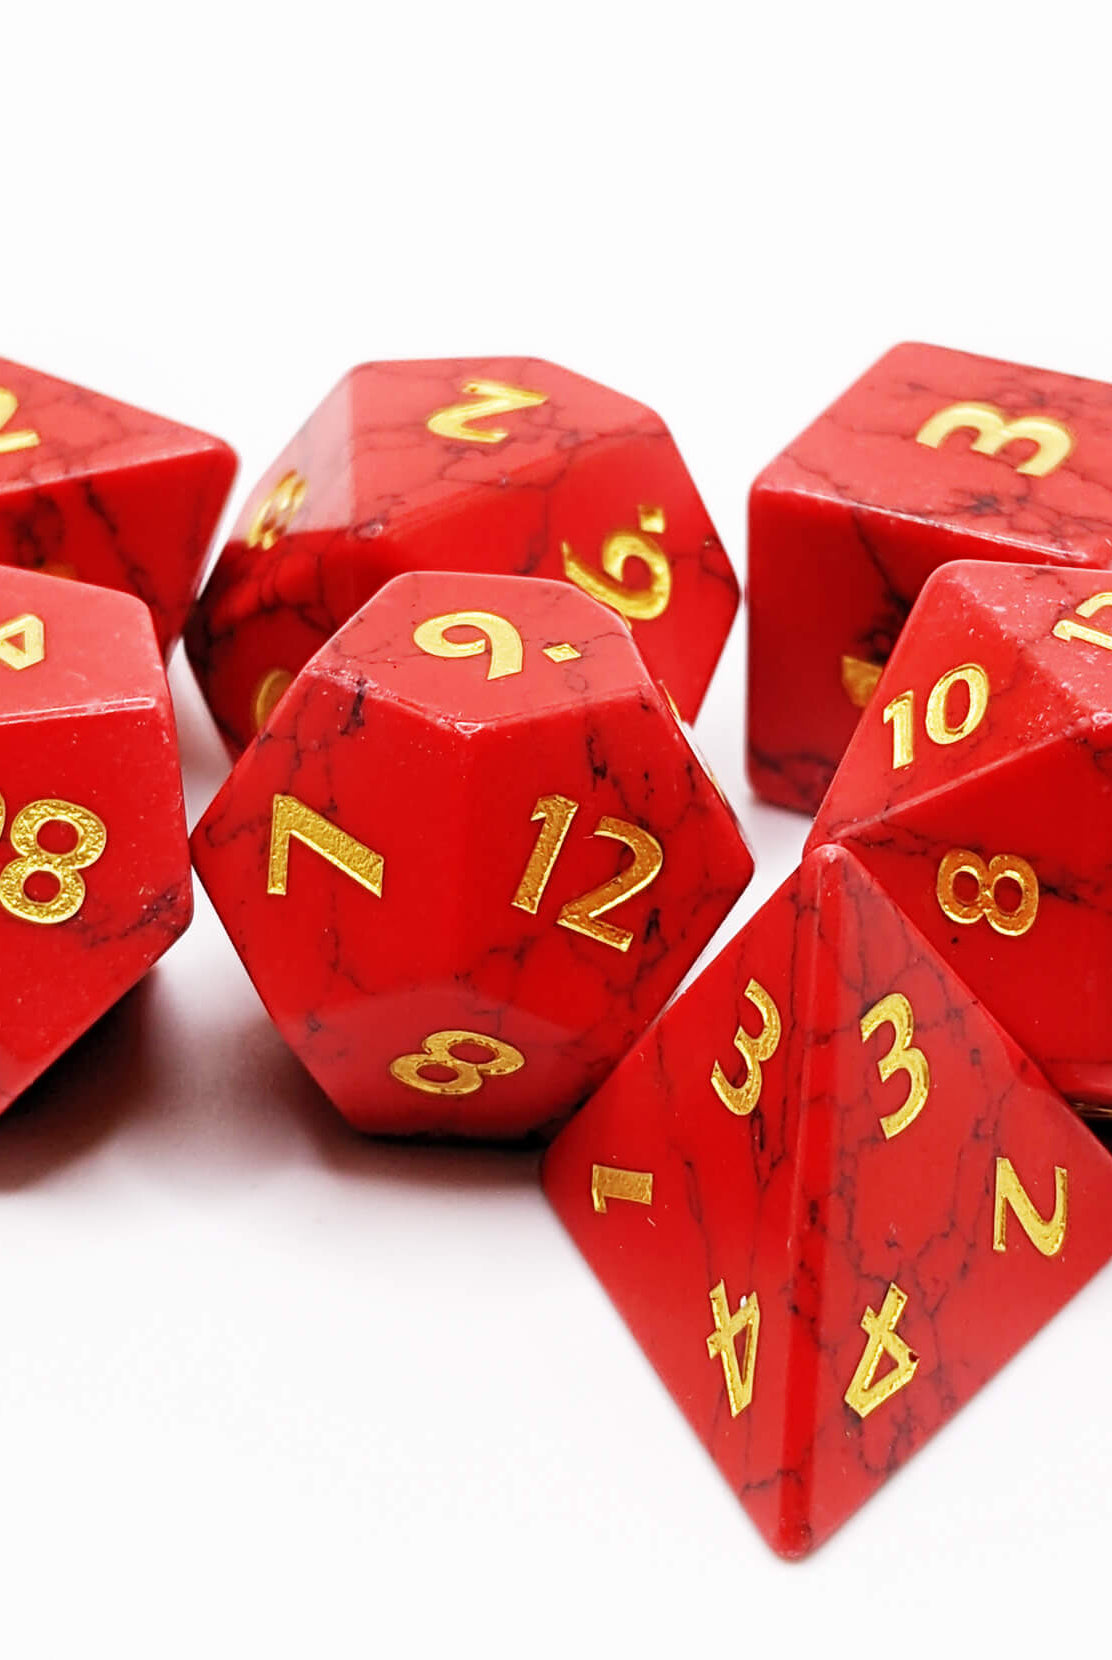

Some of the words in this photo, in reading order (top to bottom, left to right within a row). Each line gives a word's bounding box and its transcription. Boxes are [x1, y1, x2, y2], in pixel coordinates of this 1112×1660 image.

[426, 379, 548, 444] 2
[916, 401, 1075, 477] 3
[1052, 591, 1112, 651] 1
[882, 662, 990, 770] 10
[0, 792, 107, 925] 8
[266, 794, 385, 898] 7
[510, 794, 664, 953] 12
[937, 848, 1040, 937] 8
[389, 1029, 525, 1096] 8
[710, 978, 782, 1117] 3
[859, 992, 930, 1140] 3
[591, 1163, 654, 1214] 1
[992, 1156, 1069, 1257] 2
[705, 1278, 761, 1419] 4
[843, 1281, 921, 1419] 4
